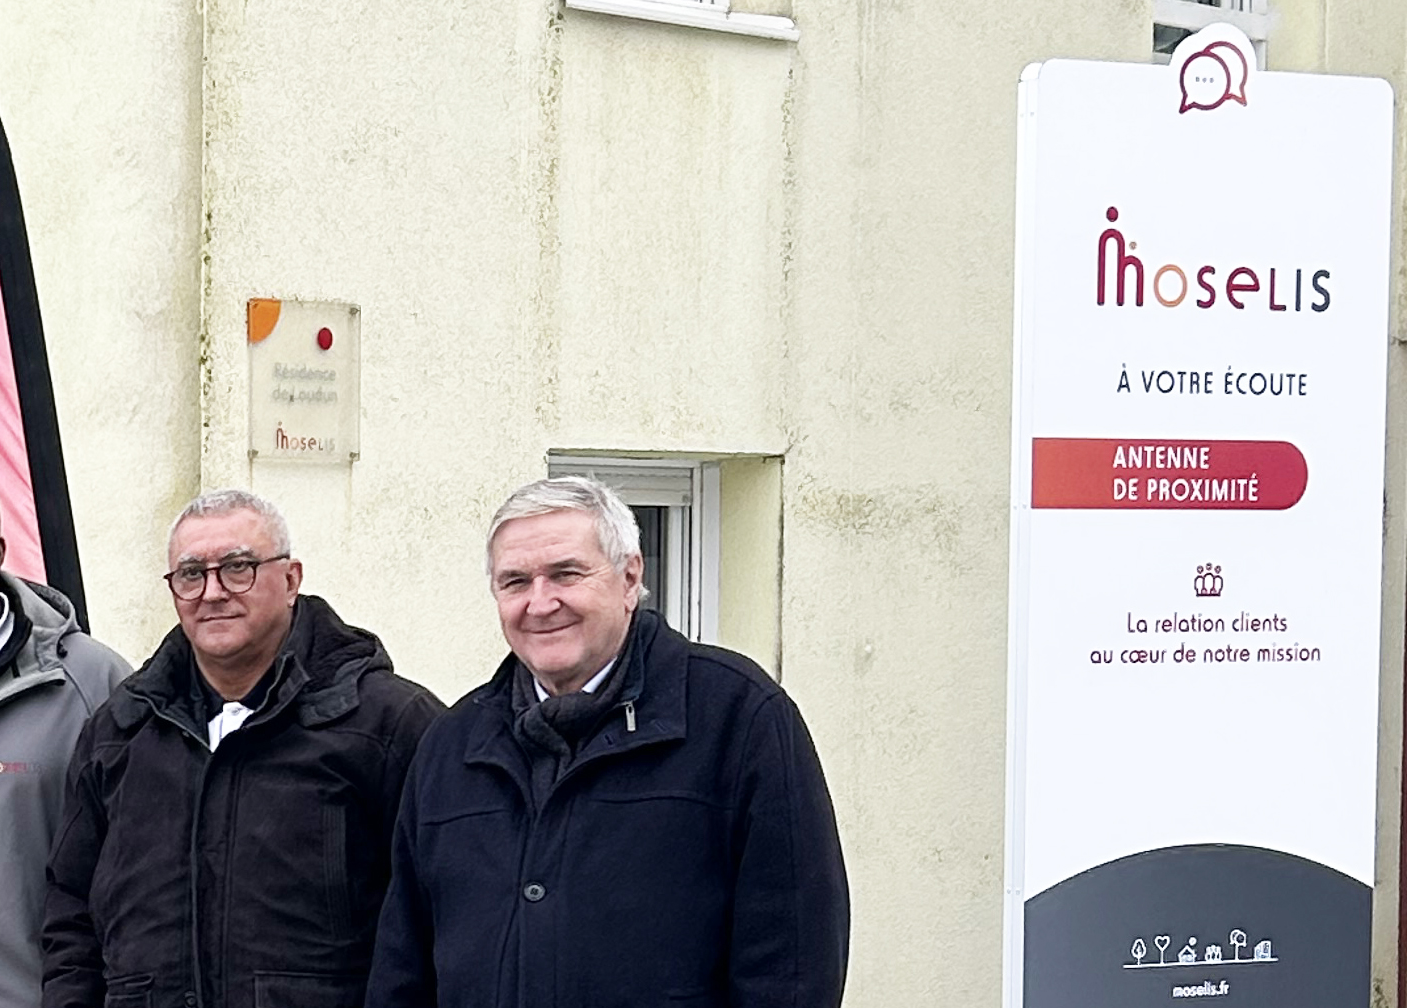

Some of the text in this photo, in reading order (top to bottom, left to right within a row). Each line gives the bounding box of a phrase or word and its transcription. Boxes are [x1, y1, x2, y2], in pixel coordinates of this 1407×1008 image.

[1116, 362, 1308, 396] À VOTRE ÉCOUTE
[1112, 445, 1211, 470] ANTENNE
[1113, 472, 1260, 502] DE PROXIMITÉ
[1127, 611, 1288, 633] La relation clients
[1090, 642, 1322, 664] au cœur de notre mission
[1172, 980, 1230, 998] moselis.fr
